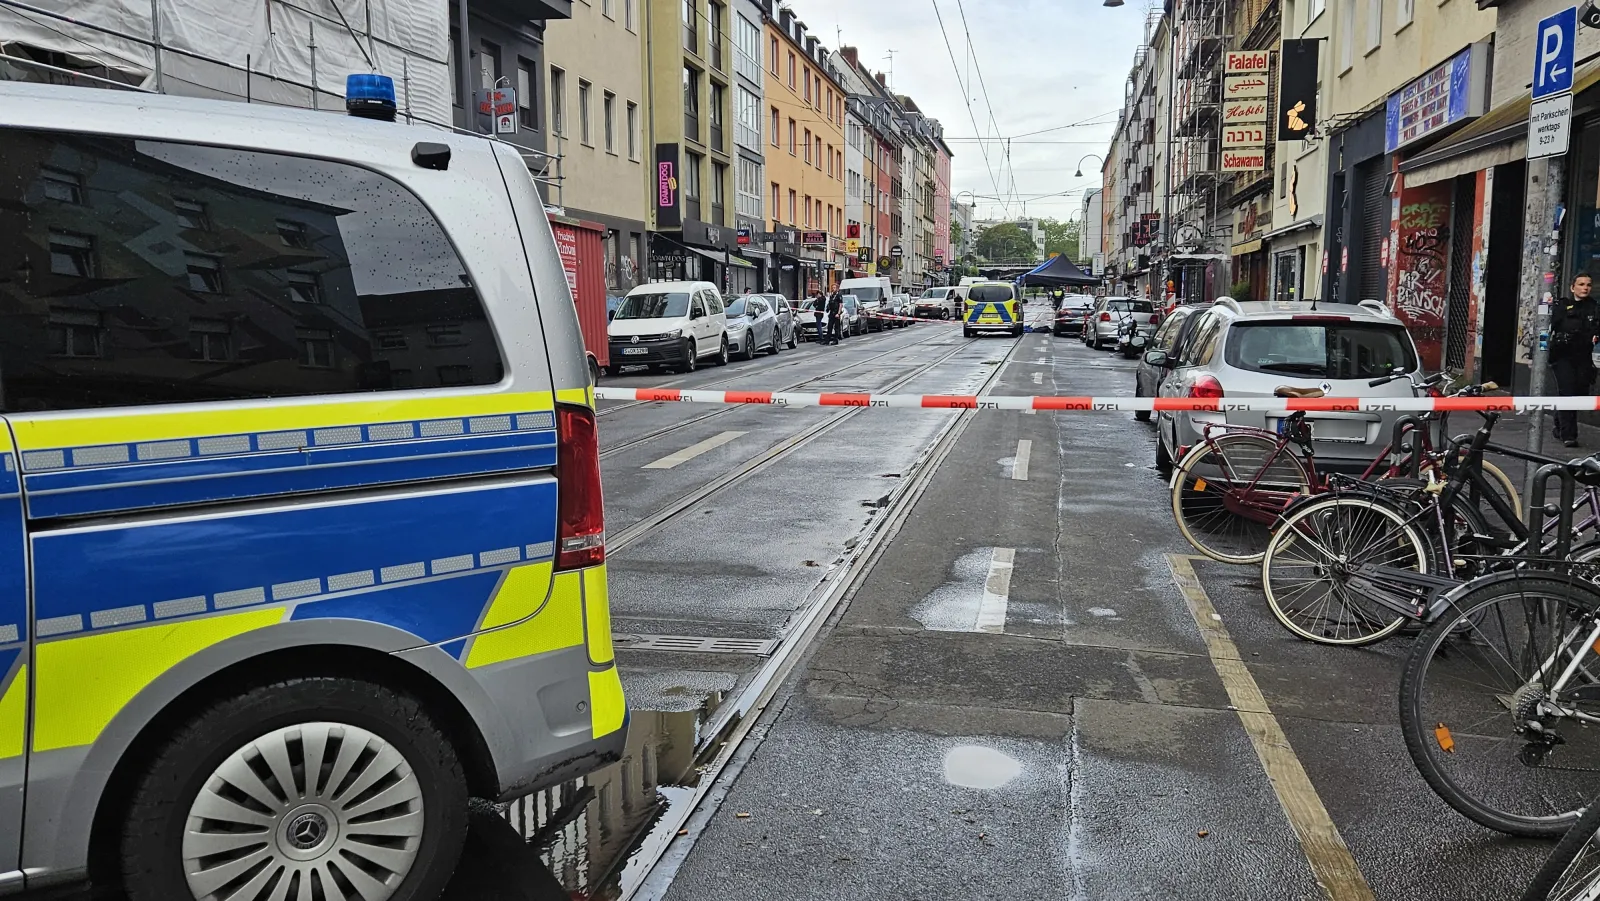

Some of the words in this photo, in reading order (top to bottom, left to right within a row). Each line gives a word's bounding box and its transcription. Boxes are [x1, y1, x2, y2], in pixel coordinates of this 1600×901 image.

[1228, 53, 1267, 70] Falafel
[1228, 79, 1266, 93] حبيبي
[1226, 104, 1265, 119] Habibi
[1531, 114, 1540, 122] mit
[1540, 108, 1569, 121] Parkschein
[1537, 123, 1560, 133] werktags
[1226, 130, 1263, 142] ברכה
[1223, 153, 1264, 168] Schawarma
[661, 182, 669, 204] DAMN
